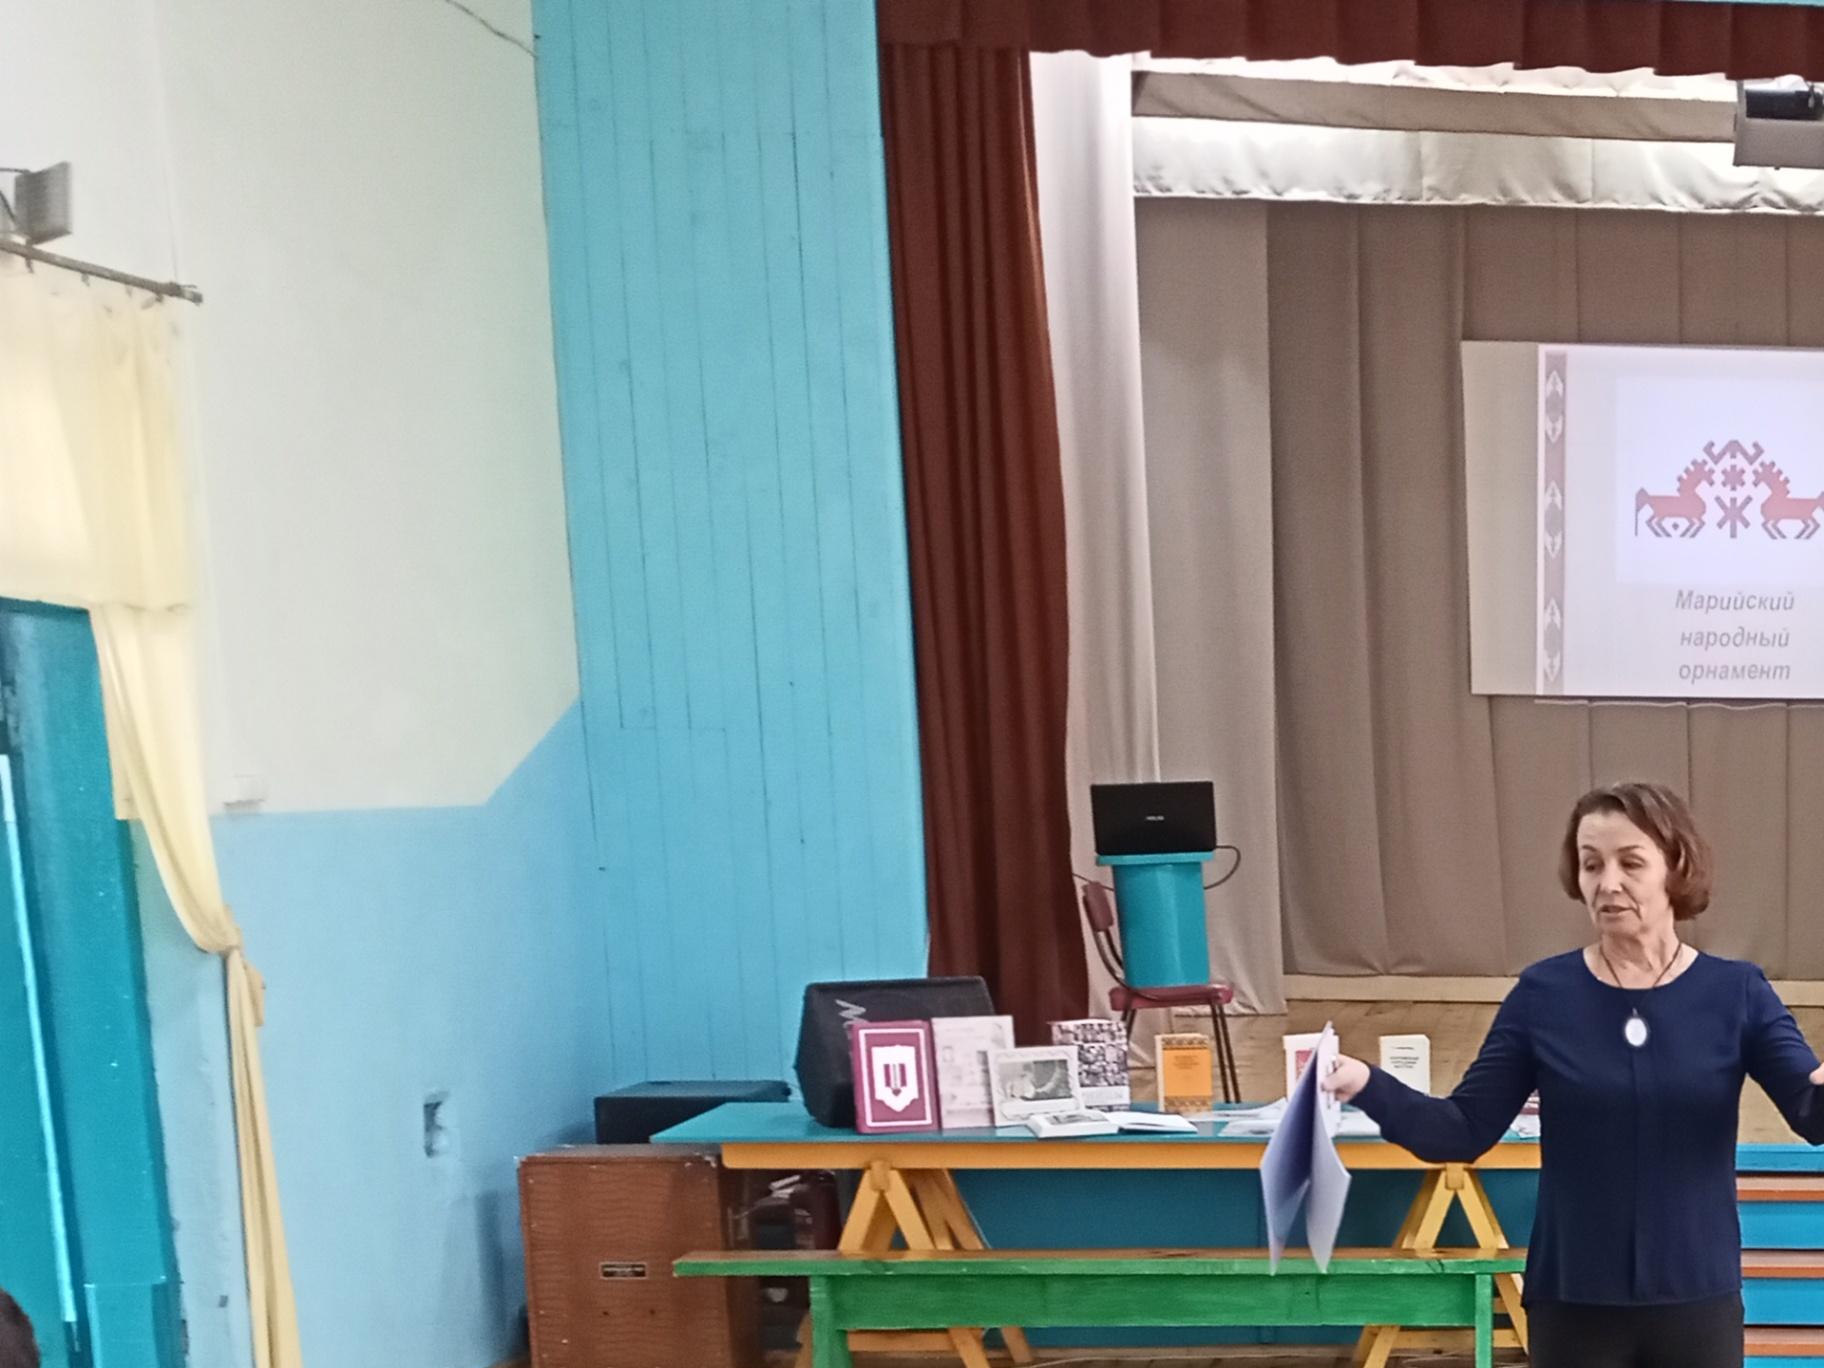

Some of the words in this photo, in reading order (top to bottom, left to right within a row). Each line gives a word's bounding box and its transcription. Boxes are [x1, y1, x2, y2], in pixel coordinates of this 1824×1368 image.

[1674, 588, 1796, 614] Марийский
[1679, 625, 1791, 651] народный
[1678, 662, 1792, 685] орнамент
